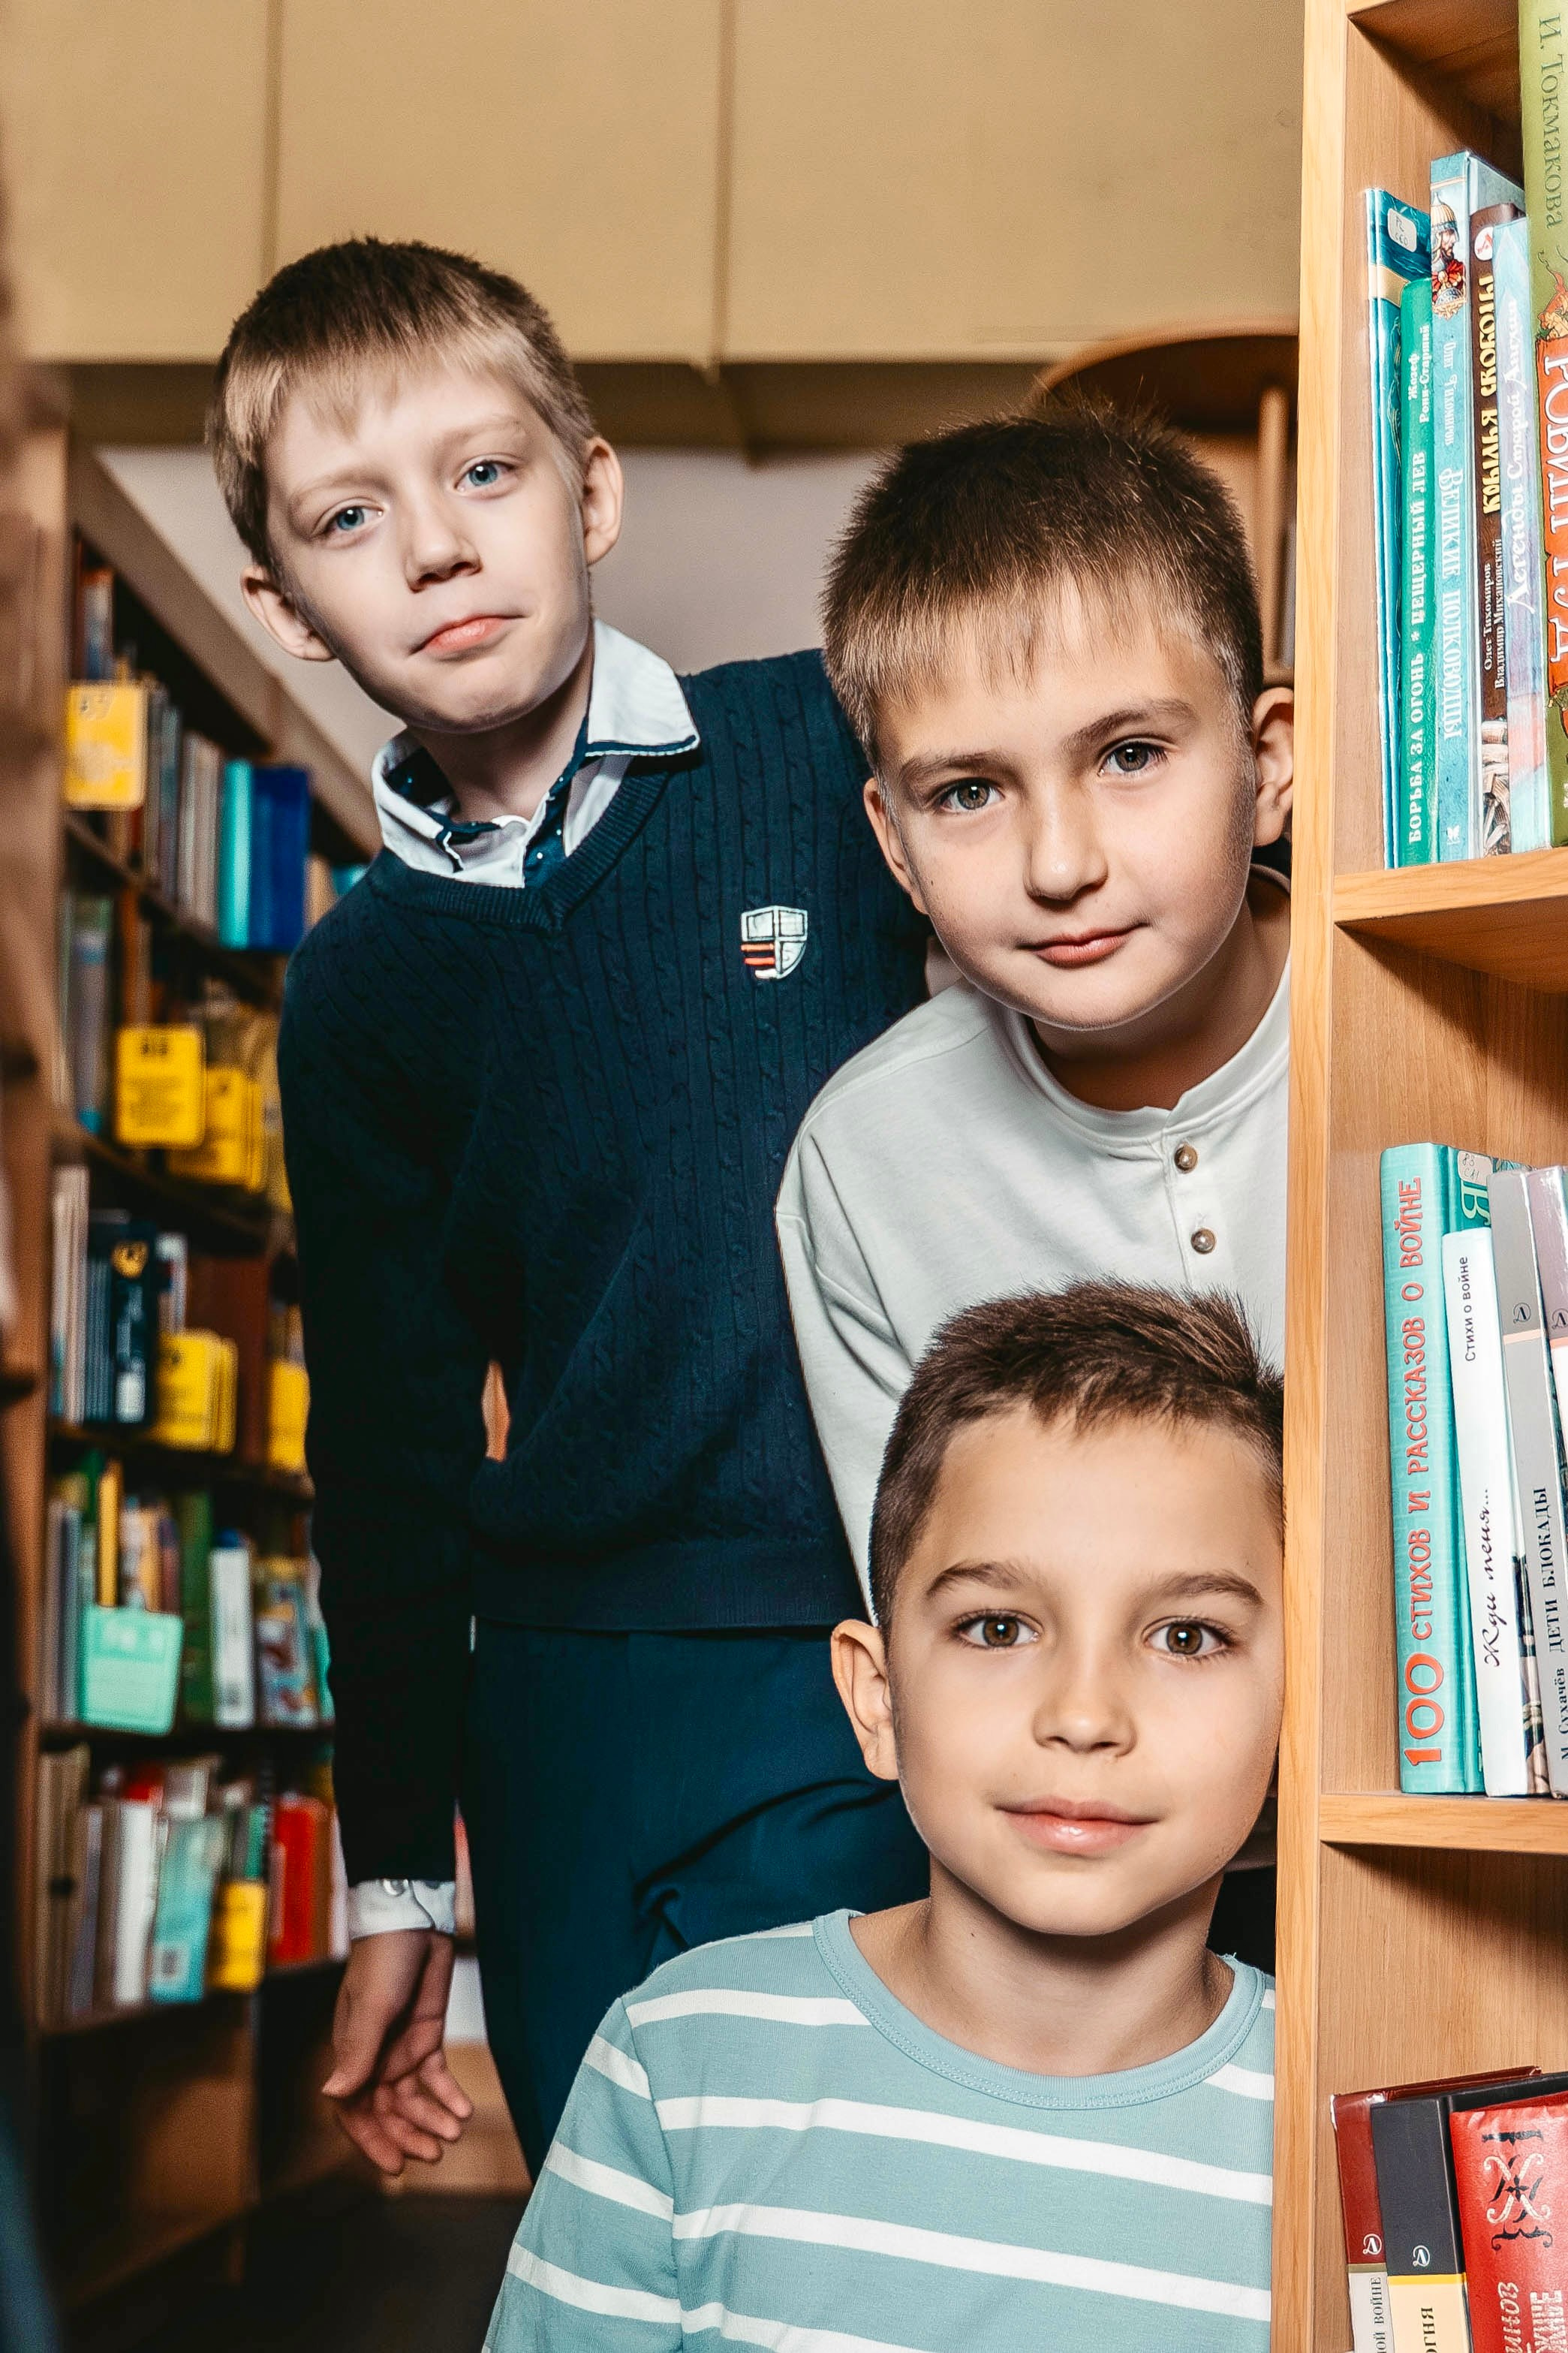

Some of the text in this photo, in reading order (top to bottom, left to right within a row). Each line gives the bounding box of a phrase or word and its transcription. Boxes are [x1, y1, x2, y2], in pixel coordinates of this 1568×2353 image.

[1538, 15, 1566, 230] И. Токмакова
[1506, 390, 1529, 480] Старой
[1501, 484, 1535, 614] Легенды
[1408, 450, 1428, 844] БОРЬБА ЗА ОГОНЬ ПЕЩЕРНЫЙ ЛЕВ
[1441, 590, 1463, 740] ПОЛКОВОДЦЫ
[1482, 562, 1493, 671] Олег Тихомиров
[1494, 624, 1506, 690] Владимир
[1458, 1255, 1472, 1300] войне
[1464, 1317, 1476, 1362] Стихи
[1394, 1176, 1445, 1766] 100 СТИХОВ И РАССКАЗОВ О ВОЙНЕ
[1478, 1489, 1507, 1668] Жди меня...
[1533, 1487, 1557, 1595] БЛОКАДЫ
[1540, 1598, 1563, 1653] ДЕТИ
[1370, 2277, 1385, 2325] ВОЙНЕ
